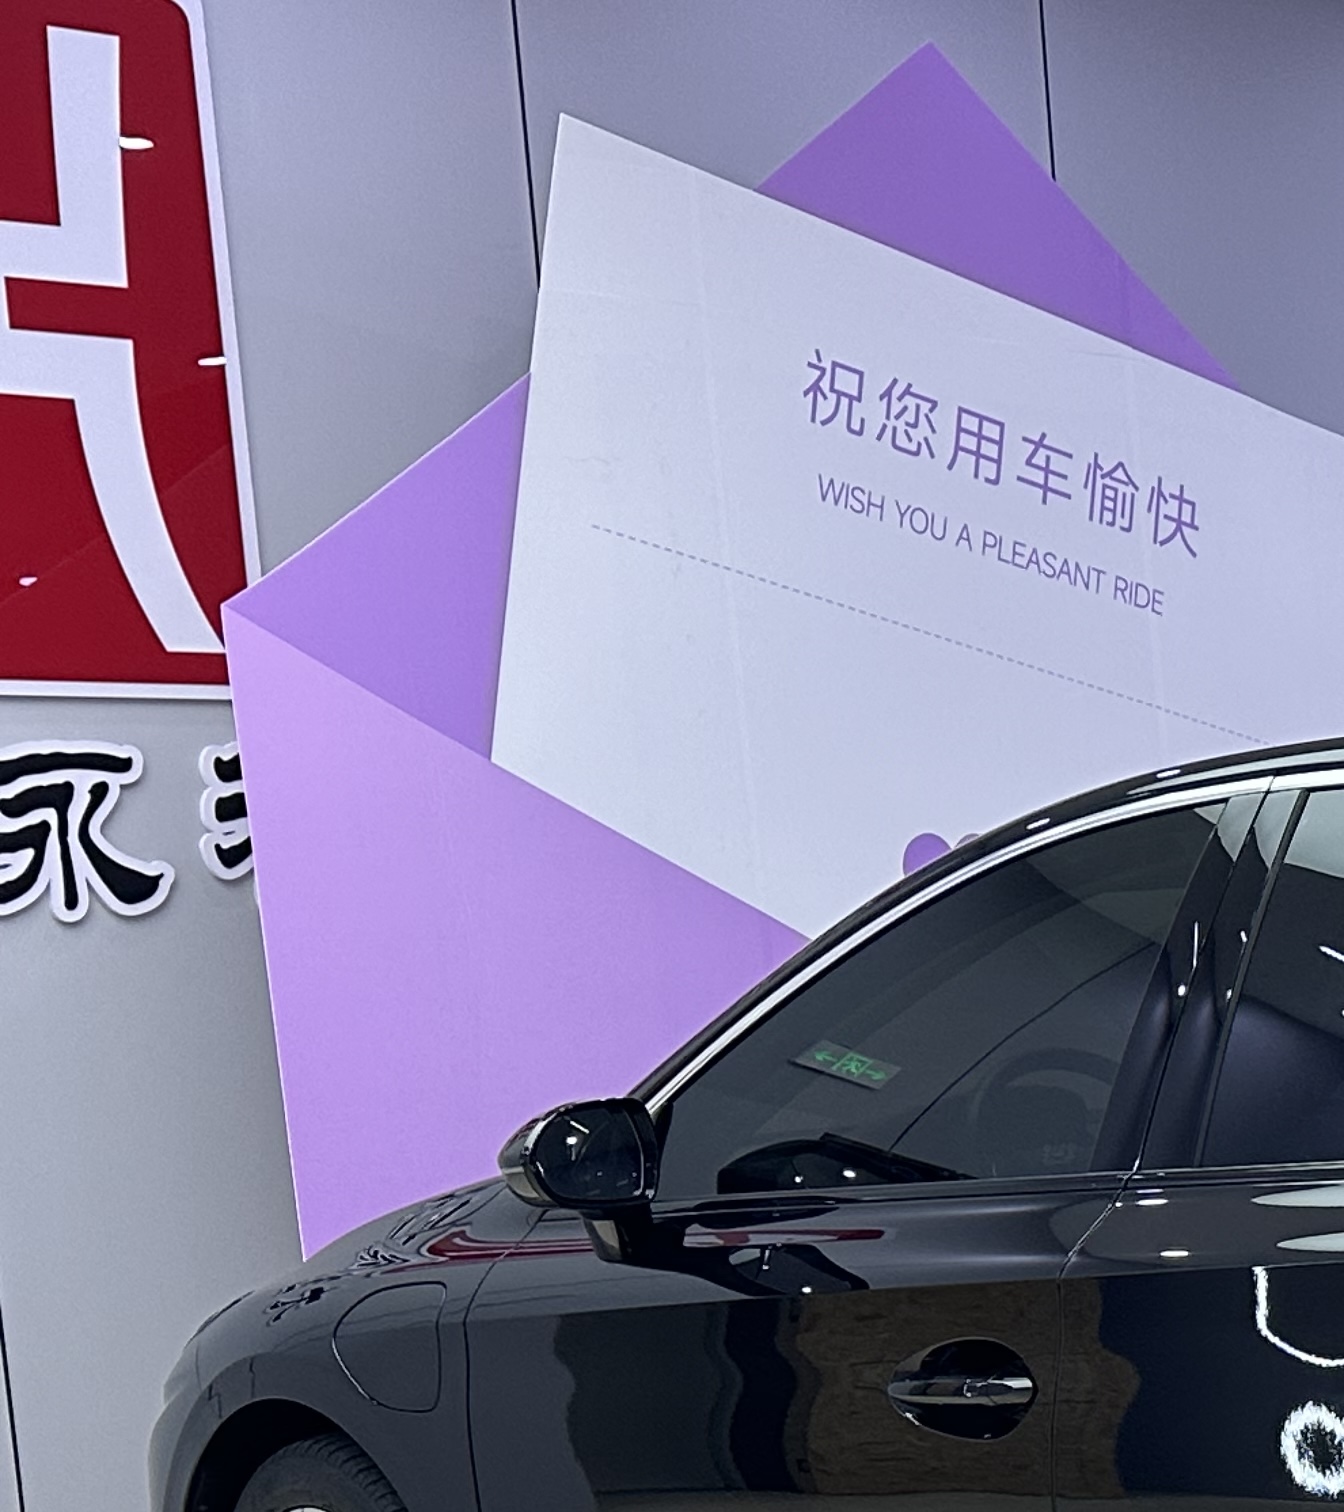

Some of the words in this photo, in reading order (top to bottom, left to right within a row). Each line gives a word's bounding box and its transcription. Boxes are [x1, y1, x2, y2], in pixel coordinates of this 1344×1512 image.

[803, 348, 1200, 558] 祝您用车愉快
[817, 473, 886, 523] WISH
[894, 499, 949, 542] YOU
[955, 523, 974, 553] A
[980, 530, 1107, 596] PLEASANT
[1113, 575, 1166, 618] RIDE
